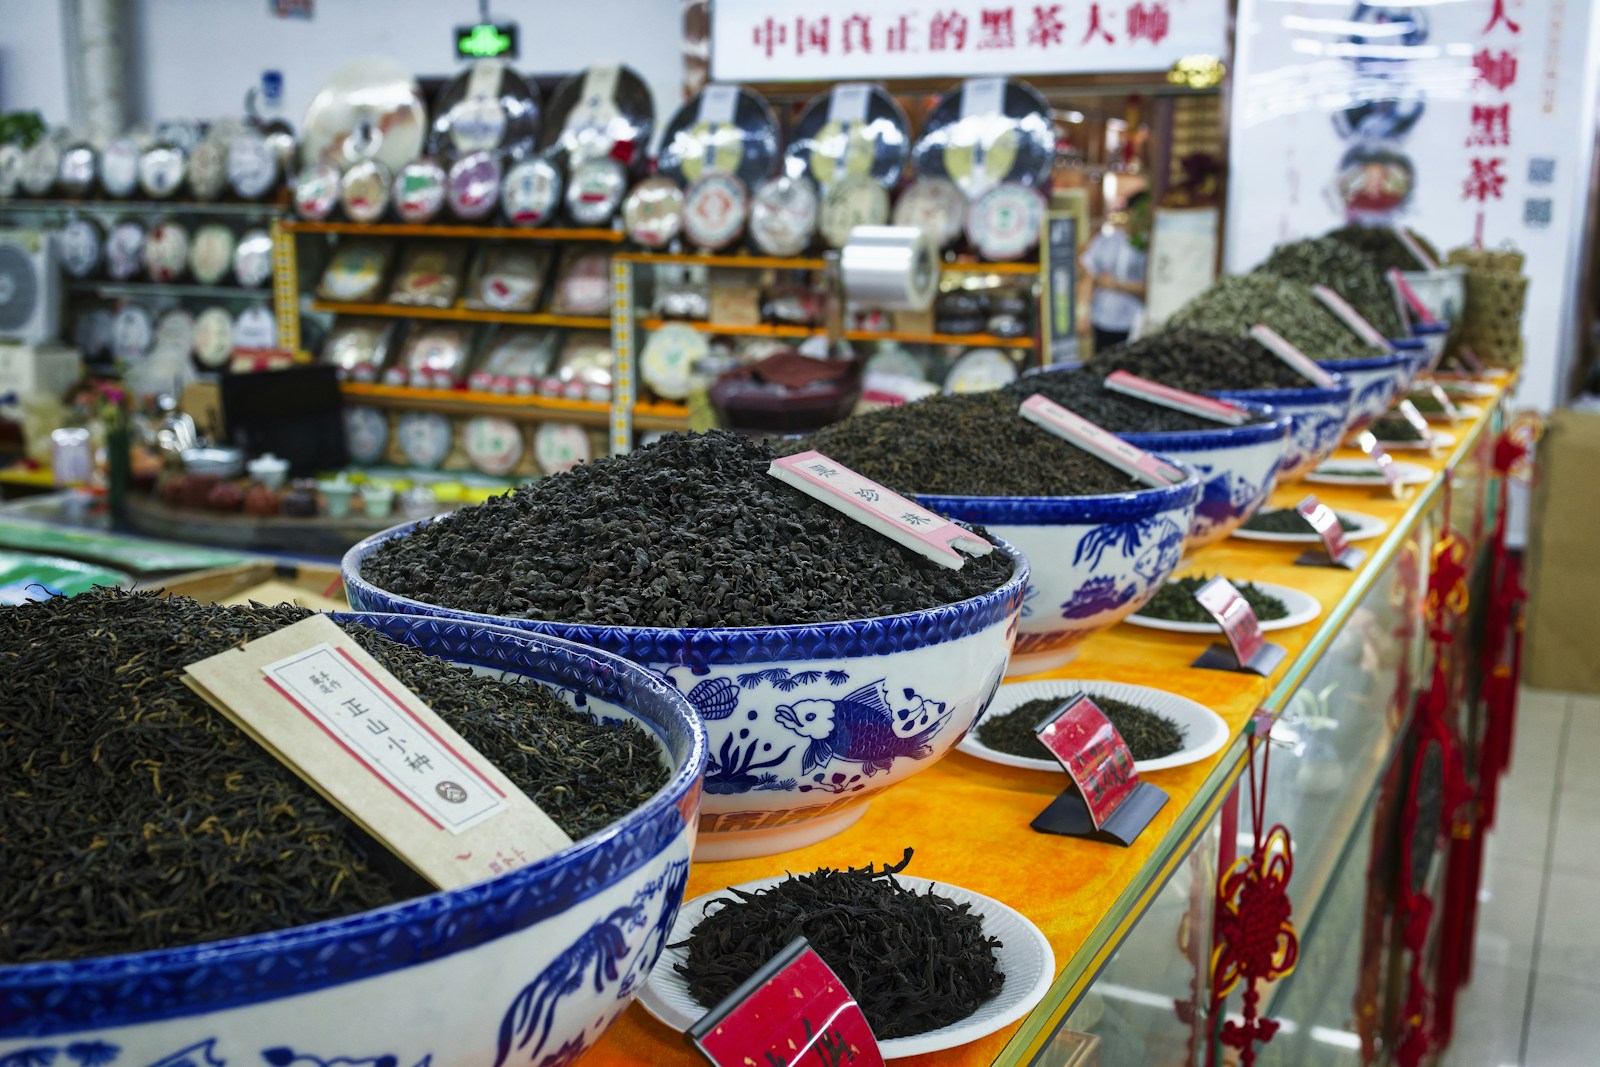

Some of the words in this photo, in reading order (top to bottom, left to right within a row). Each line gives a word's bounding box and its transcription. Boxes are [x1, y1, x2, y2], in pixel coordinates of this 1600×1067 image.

[809, 464, 931, 526] 黑珍珠
[340, 697, 434, 774] 正山小种
